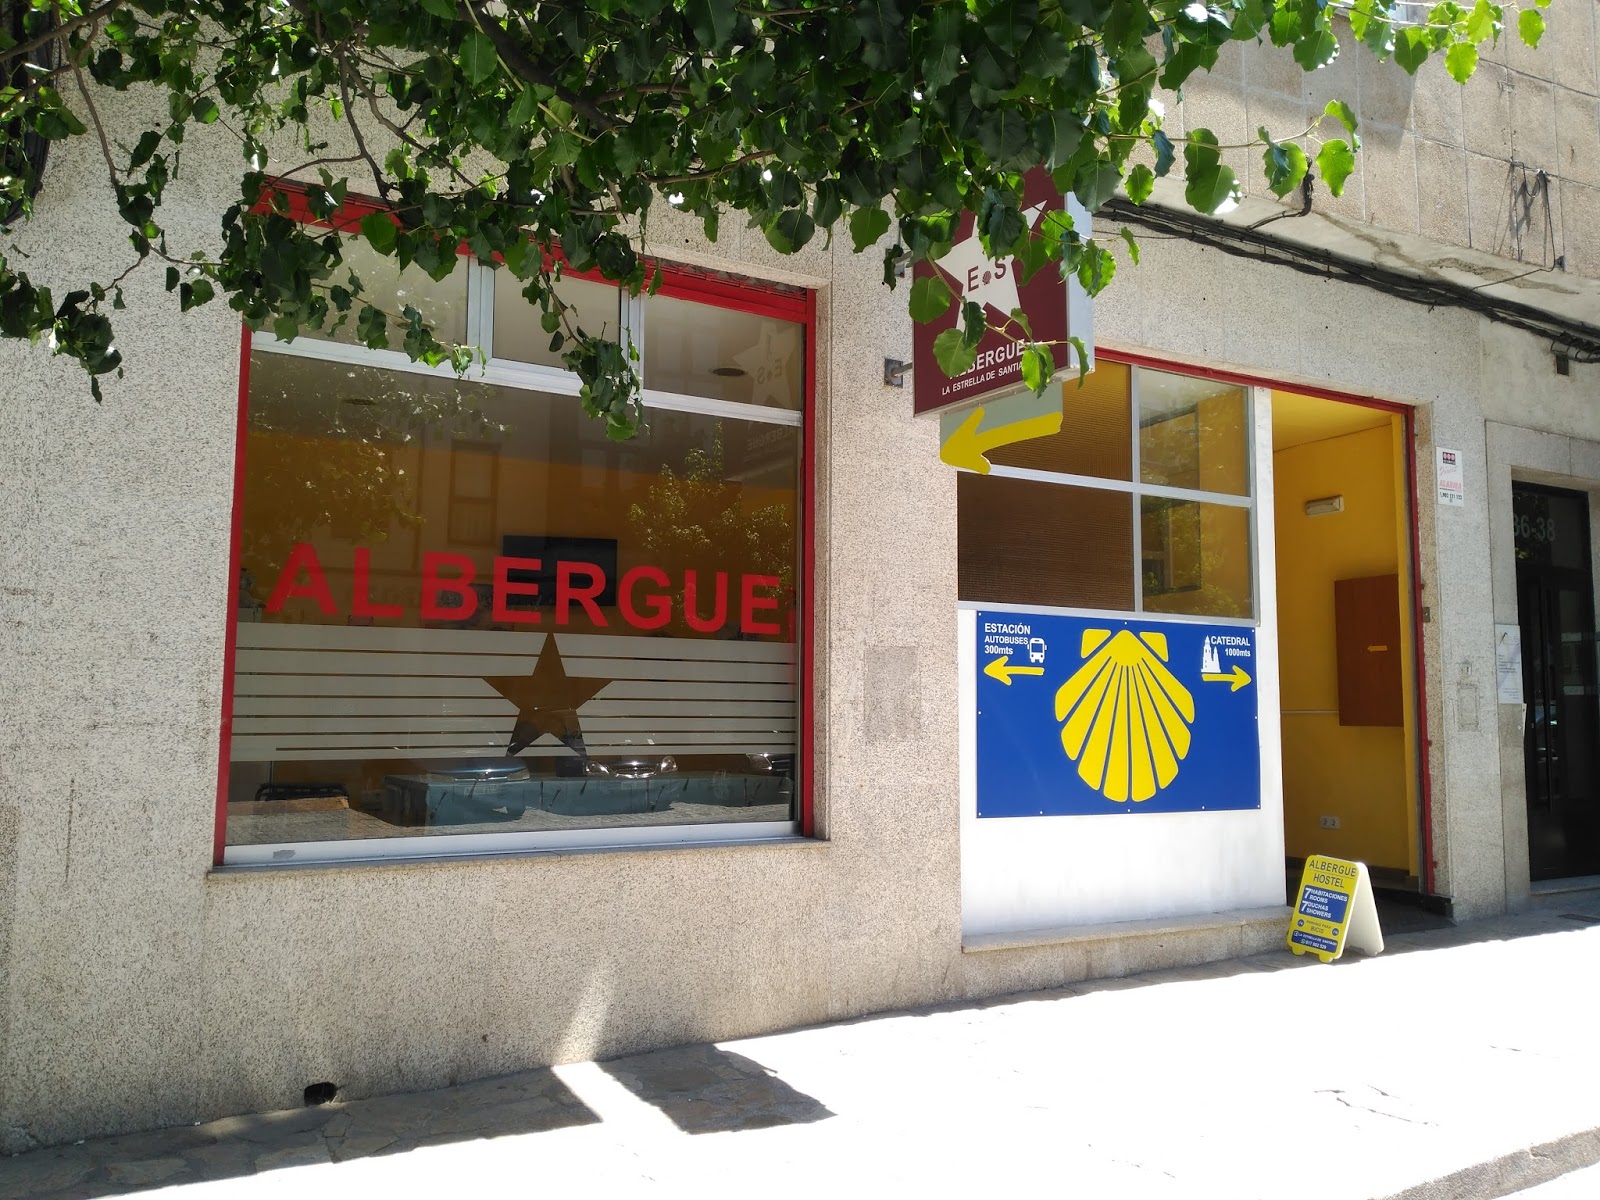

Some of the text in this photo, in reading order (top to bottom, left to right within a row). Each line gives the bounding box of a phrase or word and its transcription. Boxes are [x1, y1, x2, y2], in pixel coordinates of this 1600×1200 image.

[950, 338, 1026, 380] ERGUE
[942, 361, 1023, 395] LA ESTRELLA DE SANTIA
[264, 543, 781, 636] ALBERGUE
[984, 622, 1031, 635] ESTACIÓN
[984, 635, 1029, 645] AUTOBUSES
[1210, 635, 1251, 647] CATEDRAL
[984, 645, 1014, 655] 300mts
[1224, 648, 1251, 657] 1000mts
[1308, 859, 1357, 877] ALBERGUE
[1313, 873, 1345, 889] HOSTEL
[1304, 887, 1348, 902] 7 HABITACIONES
[1309, 894, 1329, 904] ROOMS
[1301, 900, 1329, 912] 7 DUCHAS
[1306, 907, 1332, 918] SHOWERS
